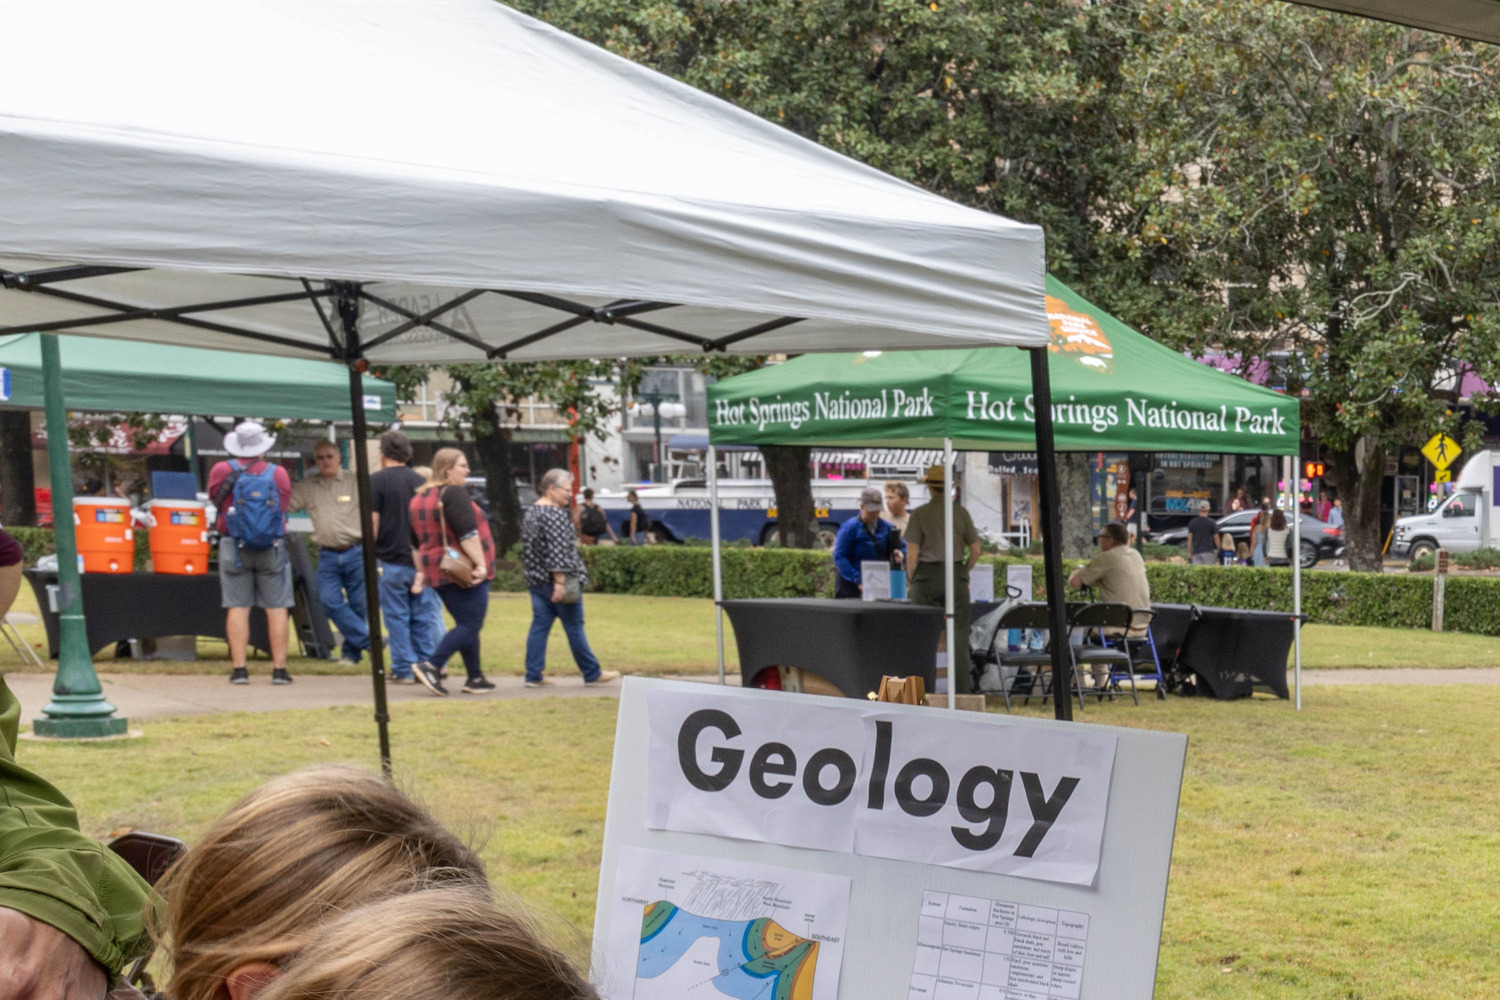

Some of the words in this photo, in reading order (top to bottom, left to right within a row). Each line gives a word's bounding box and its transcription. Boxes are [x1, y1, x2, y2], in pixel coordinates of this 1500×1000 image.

[715, 399, 746, 426] Hot
[750, 395, 811, 432] Springs
[814, 390, 888, 421] National
[892, 387, 935, 418] Park
[966, 391, 1016, 422] Hot
[1125, 397, 1227, 432] National
[1234, 406, 1287, 435] Park
[677, 498, 723, 509] NATIONL
[678, 708, 1082, 859] Geology
[811, 933, 841, 943] SOUTHEAST
